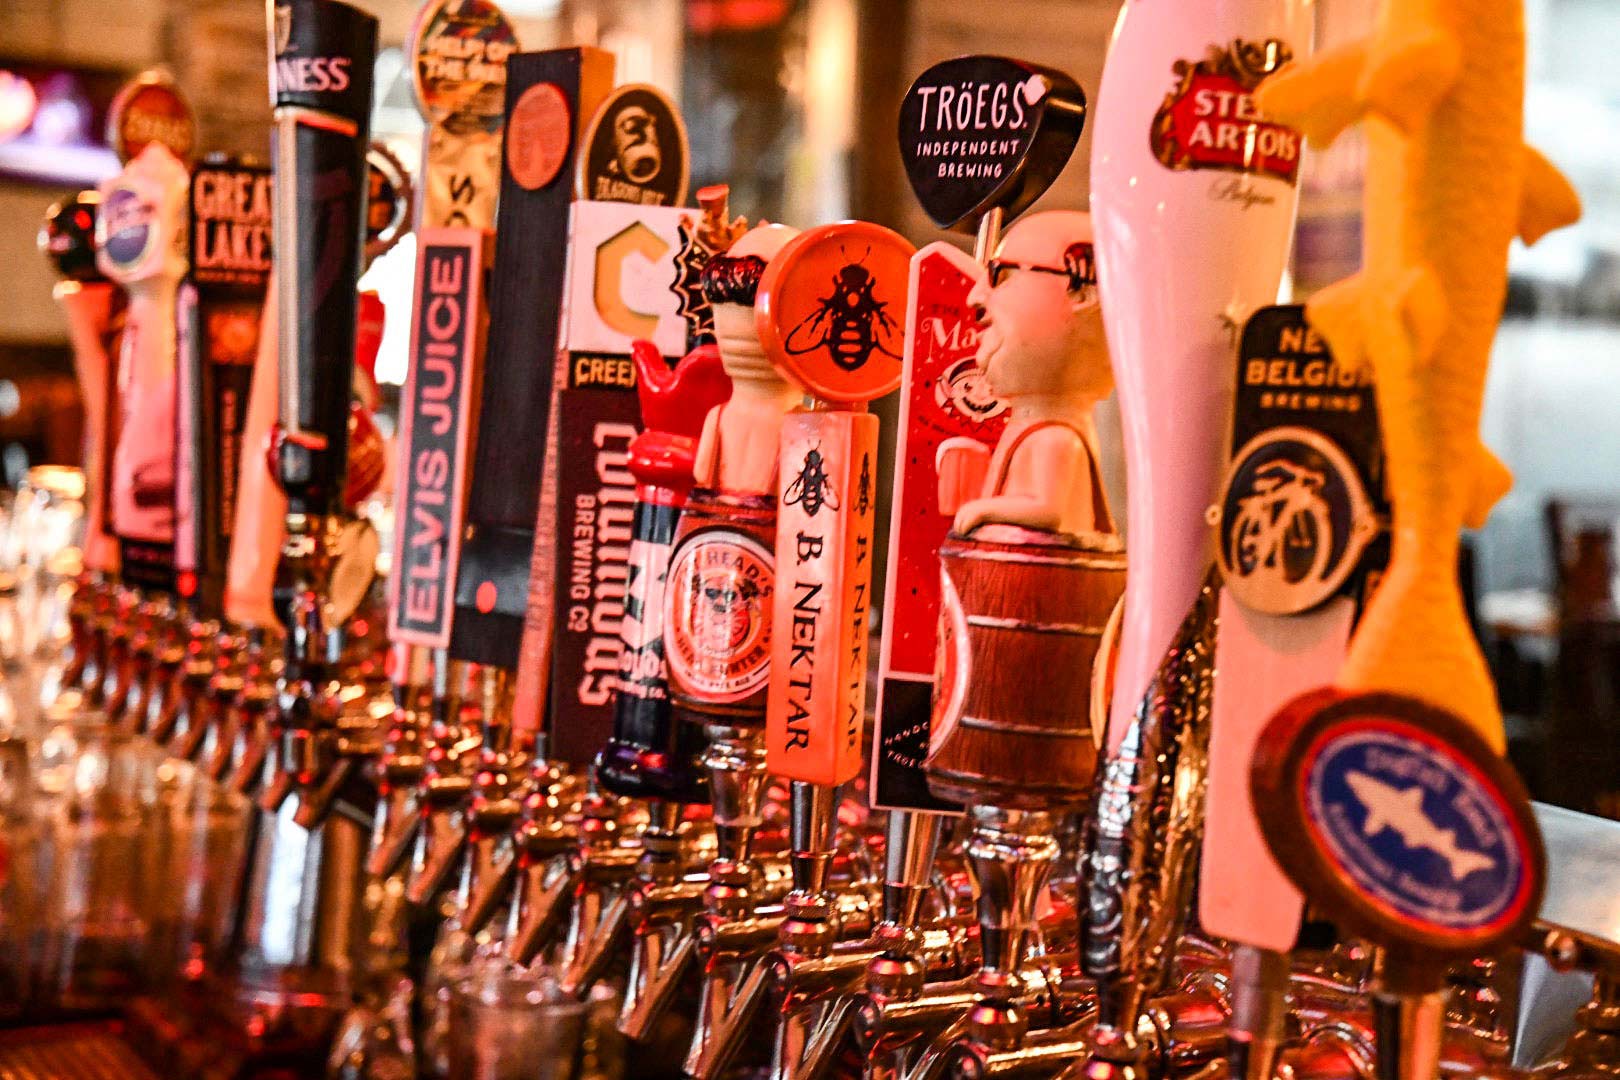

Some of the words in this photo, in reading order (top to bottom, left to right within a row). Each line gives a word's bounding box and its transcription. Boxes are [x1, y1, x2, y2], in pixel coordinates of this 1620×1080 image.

[1194, 88, 1264, 121] STE
[916, 139, 1020, 157] INDEPENDENT
[937, 162, 1003, 179] BREWING
[194, 171, 272, 220] GREA
[195, 220, 272, 270] LAKE
[420, 255, 464, 436] JUICE
[920, 317, 978, 363] Ma
[1279, 326, 1322, 353] NE
[575, 357, 637, 388] CREE
[405, 449, 450, 624] ELVIS
[571, 493, 597, 600] BREWING
[785, 581, 823, 753] NEKTAR
